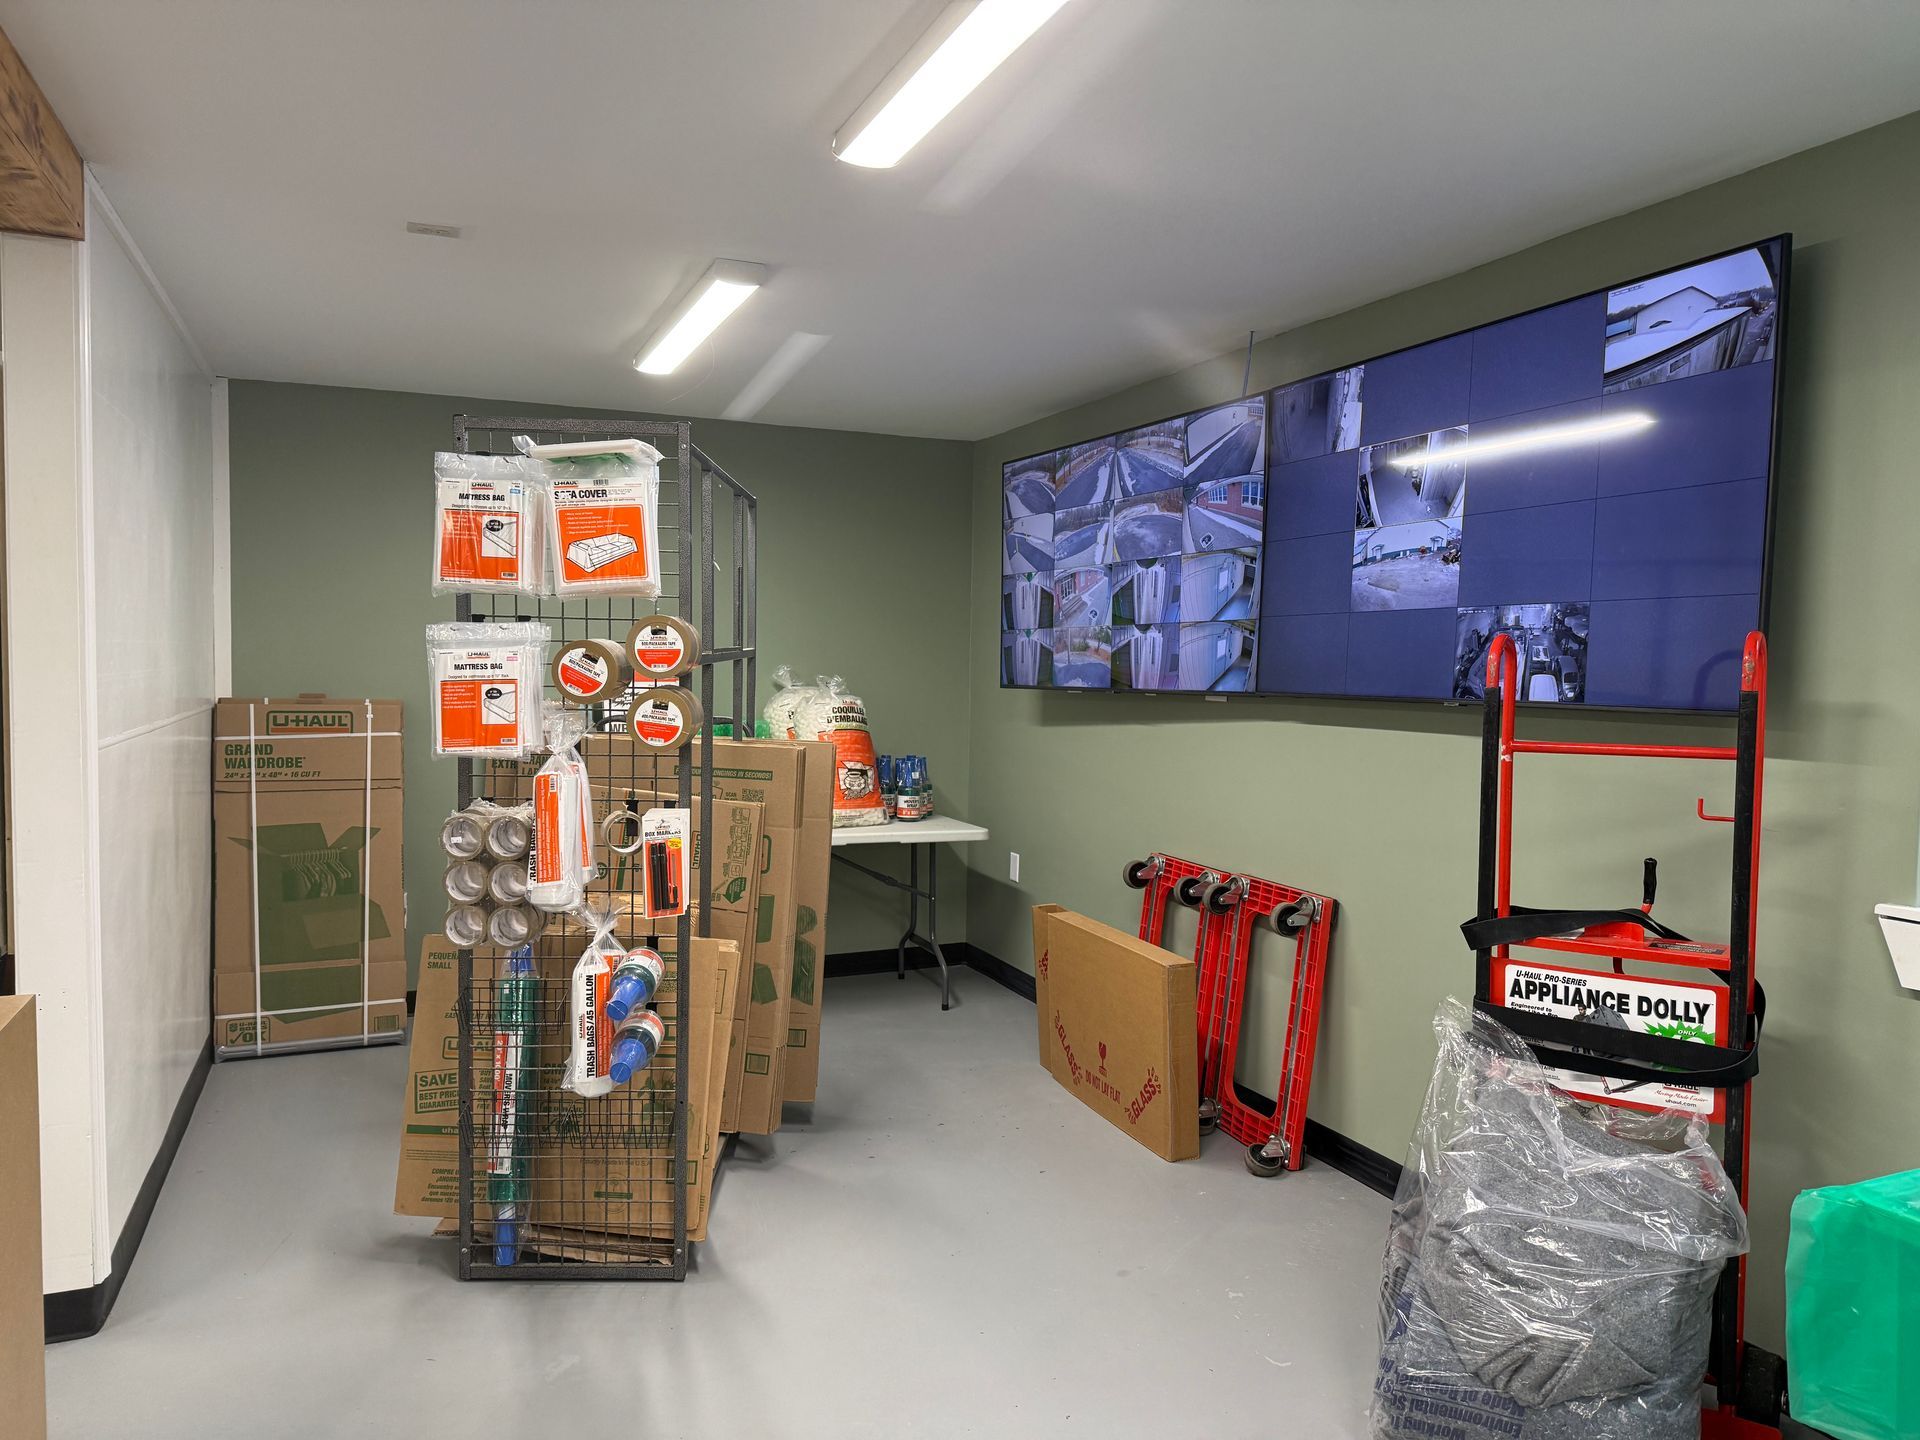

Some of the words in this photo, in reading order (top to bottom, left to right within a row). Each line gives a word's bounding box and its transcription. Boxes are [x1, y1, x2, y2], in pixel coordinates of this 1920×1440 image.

[579, 489, 608, 498] COVER
[272, 715, 348, 726] U-HAUL
[224, 744, 273, 755] GRAND
[428, 951, 459, 960] PEQUEÑ
[1516, 970, 1541, 980] U-HAUL
[1544, 974, 1587, 986] PRO-SERIES
[1509, 979, 1630, 1014] APPLIANCE
[1637, 995, 1711, 1024] DOLLY
[1511, 1002, 1544, 1011] Engineered
[587, 1010, 595, 1047] BAGS/45
[1058, 1025, 1078, 1077] GLASS
[587, 1050, 596, 1078] TRASH
[420, 1073, 457, 1087] SAVE
[1085, 1070, 1092, 1085] DO
[1092, 1075, 1100, 1091] NOT
[1101, 1080, 1109, 1097] LAY
[1110, 1087, 1120, 1104] FLAT
[419, 1092, 439, 1100] BEST
[440, 1090, 459, 1099] PRIC
[419, 1100, 458, 1109] GUARANTEE
[1132, 1078, 1157, 1119] GLASS
[1482, 1390, 1525, 1417] Made
[1403, 1416, 1466, 1440] Working
[1408, 1398, 1523, 1438] Environmental
